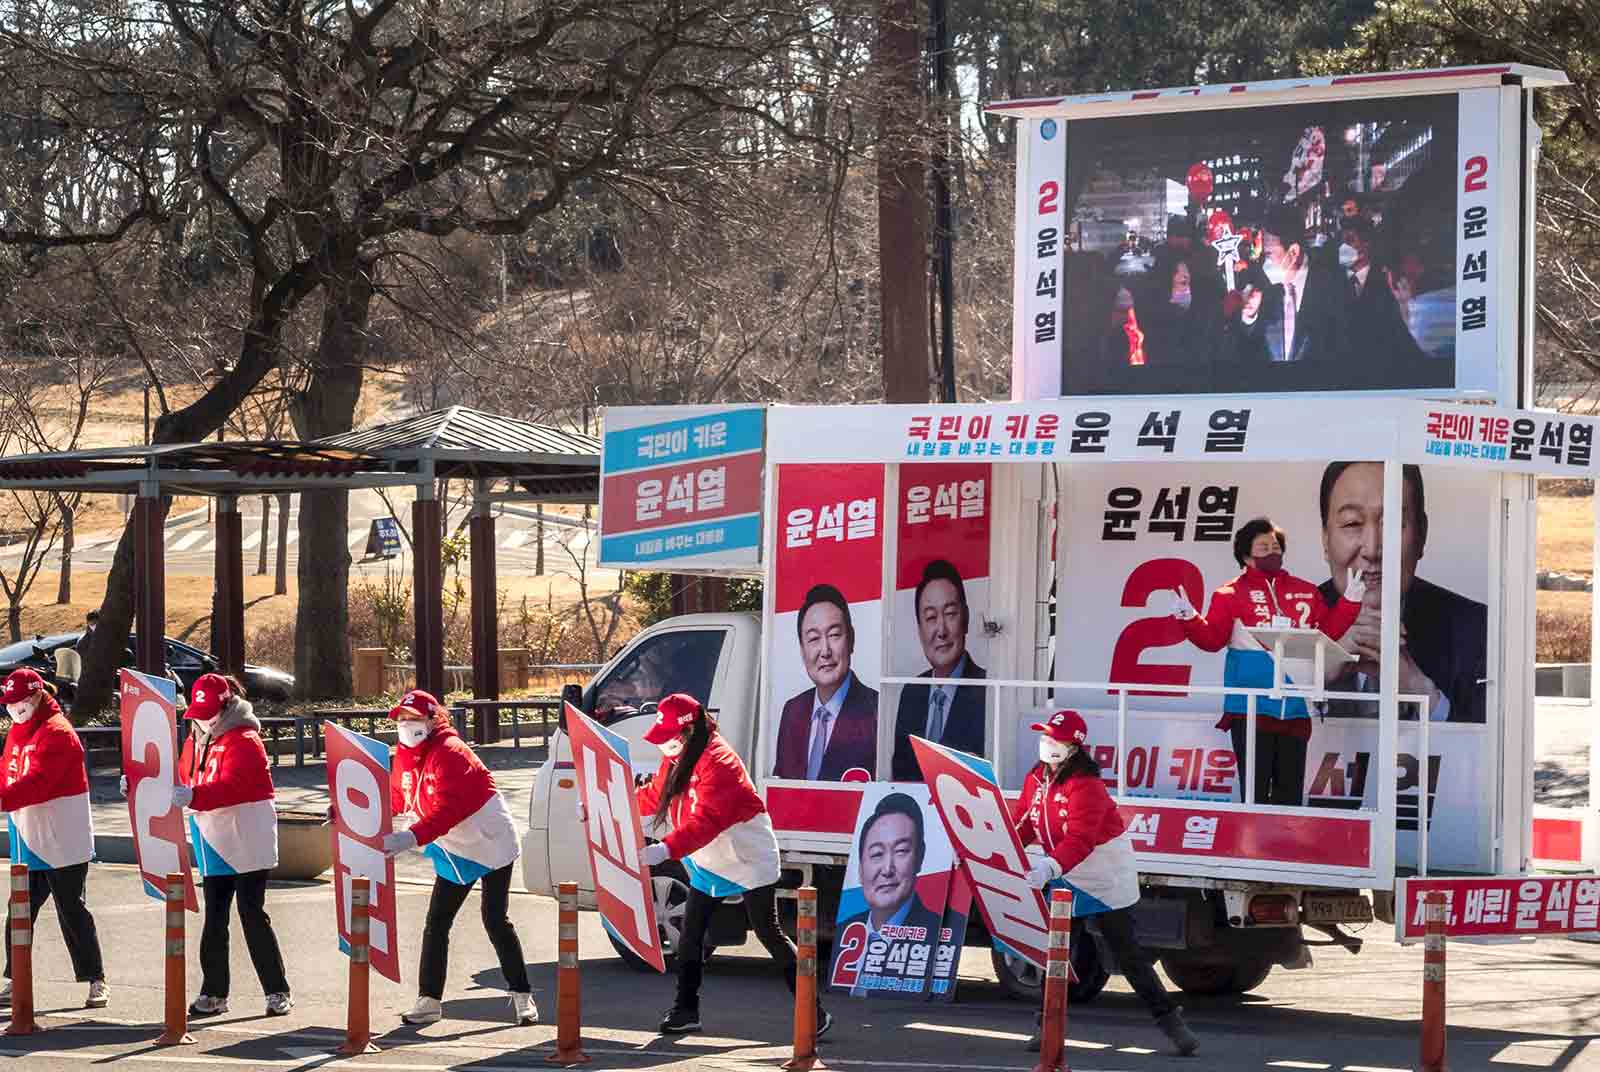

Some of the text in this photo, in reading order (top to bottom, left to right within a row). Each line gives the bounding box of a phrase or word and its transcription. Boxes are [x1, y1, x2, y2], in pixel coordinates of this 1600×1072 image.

[1039, 180, 1058, 215] 2
[1464, 155, 1488, 193] 2
[637, 421, 728, 459] 국민이 키운
[1425, 412, 1510, 444] 국민이 키운
[1509, 417, 1594, 467] 윤석열
[635, 465, 727, 522] 윤석열
[905, 479, 986, 525] 윤석열
[1101, 486, 1240, 542] 윤석열
[786, 497, 878, 549] 윤석열
[1106, 558, 1205, 697] 2
[195, 690, 206, 702] 2
[131, 700, 181, 880] 2
[576, 744, 653, 948] 석
[1463, 888, 1512, 924] 바로!
[1515, 880, 1600, 929] 윤석열
[831, 921, 869, 988] 2
[863, 940, 932, 977] 윤석열
